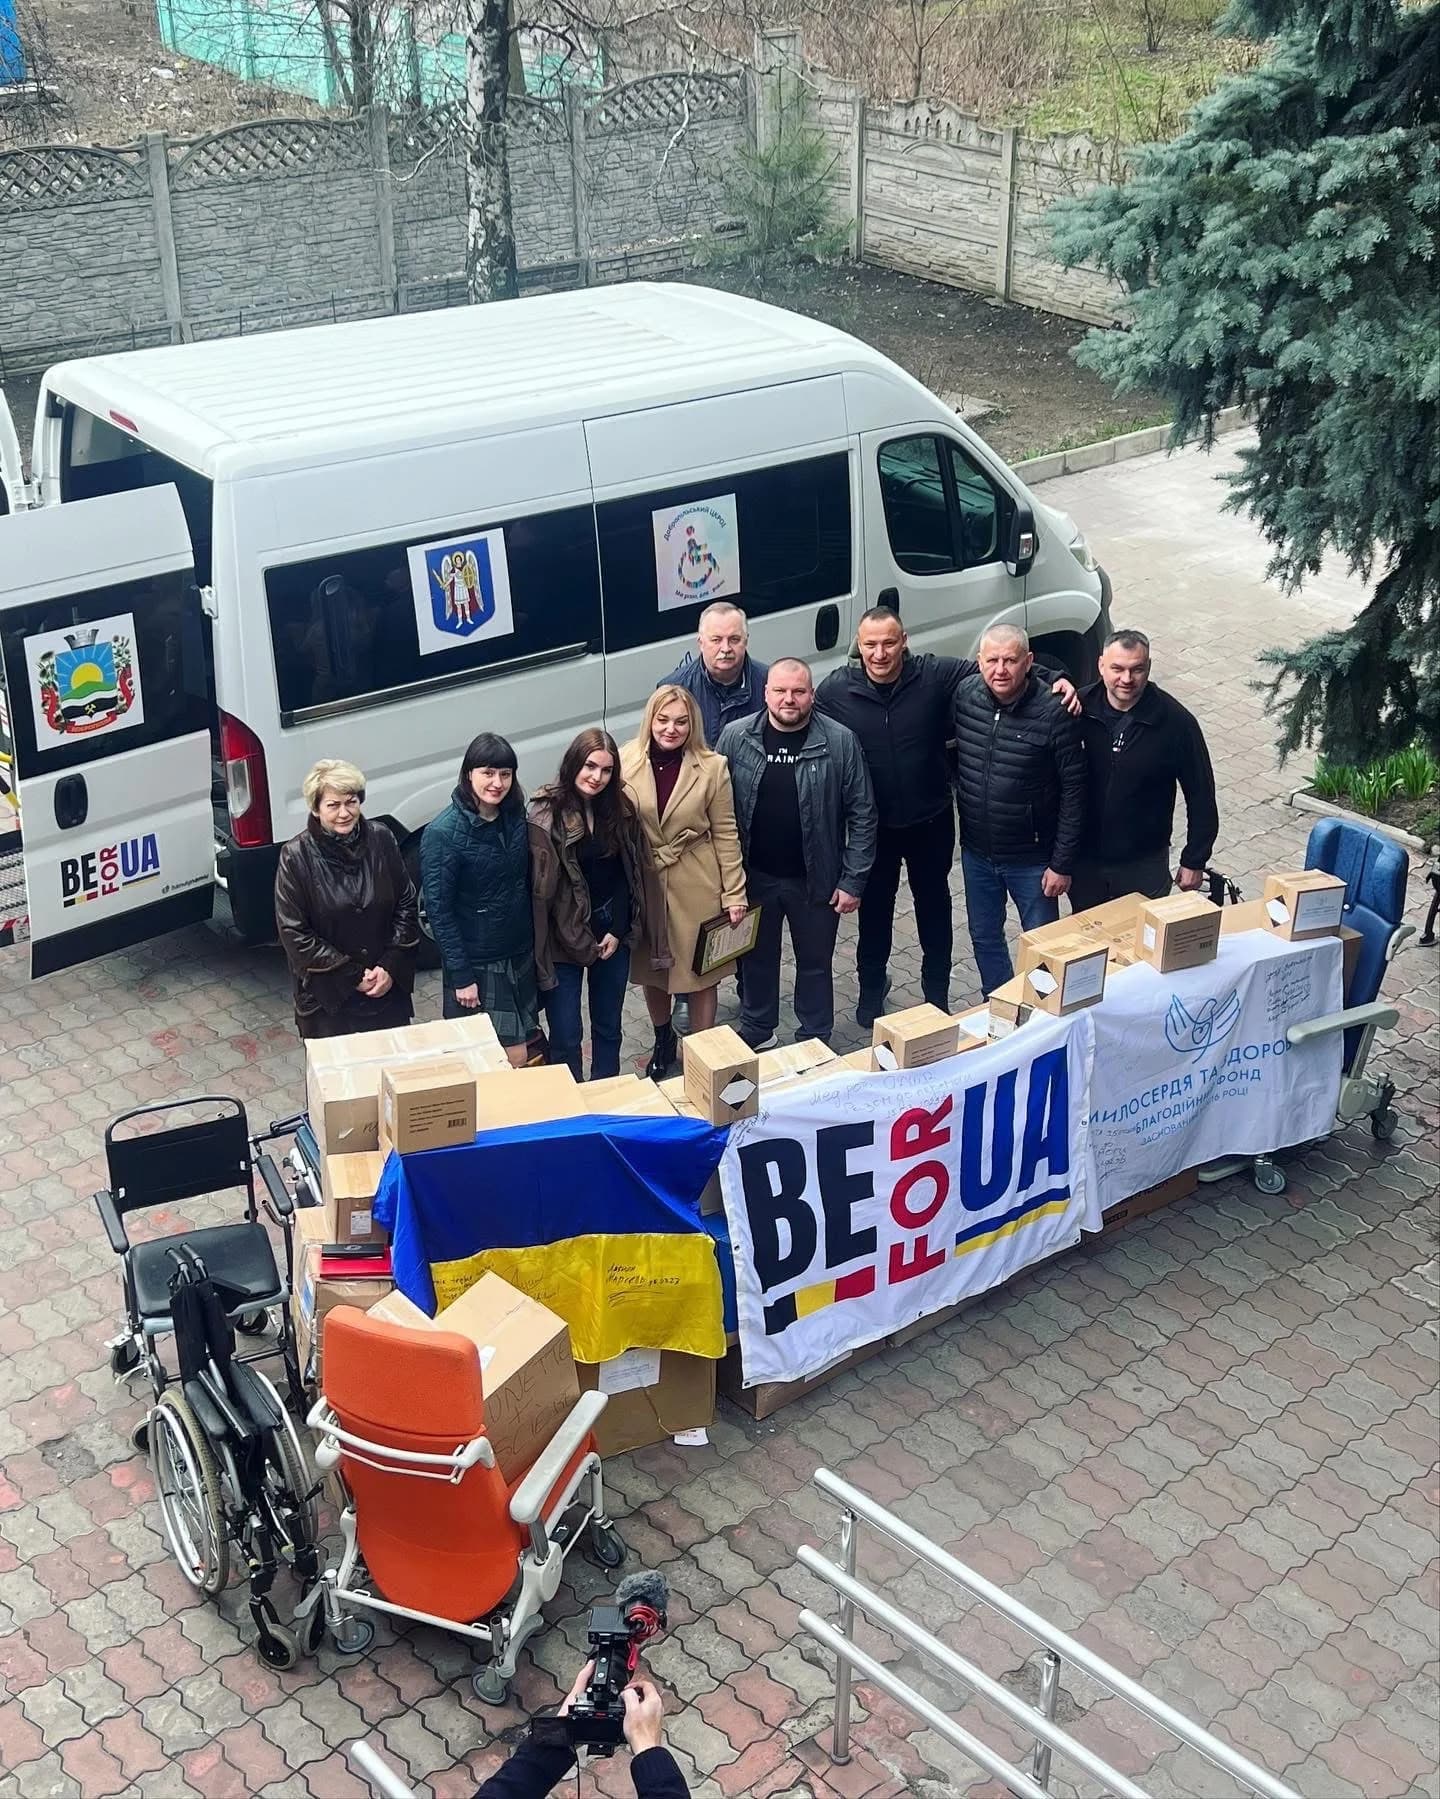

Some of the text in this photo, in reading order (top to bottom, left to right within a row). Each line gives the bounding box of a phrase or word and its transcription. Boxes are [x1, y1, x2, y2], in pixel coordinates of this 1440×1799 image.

[60, 833, 160, 898] BE FOR UA
[1200, 1066, 1218, 1085] ТА
[738, 1045, 1070, 1294] BE FOR UA
